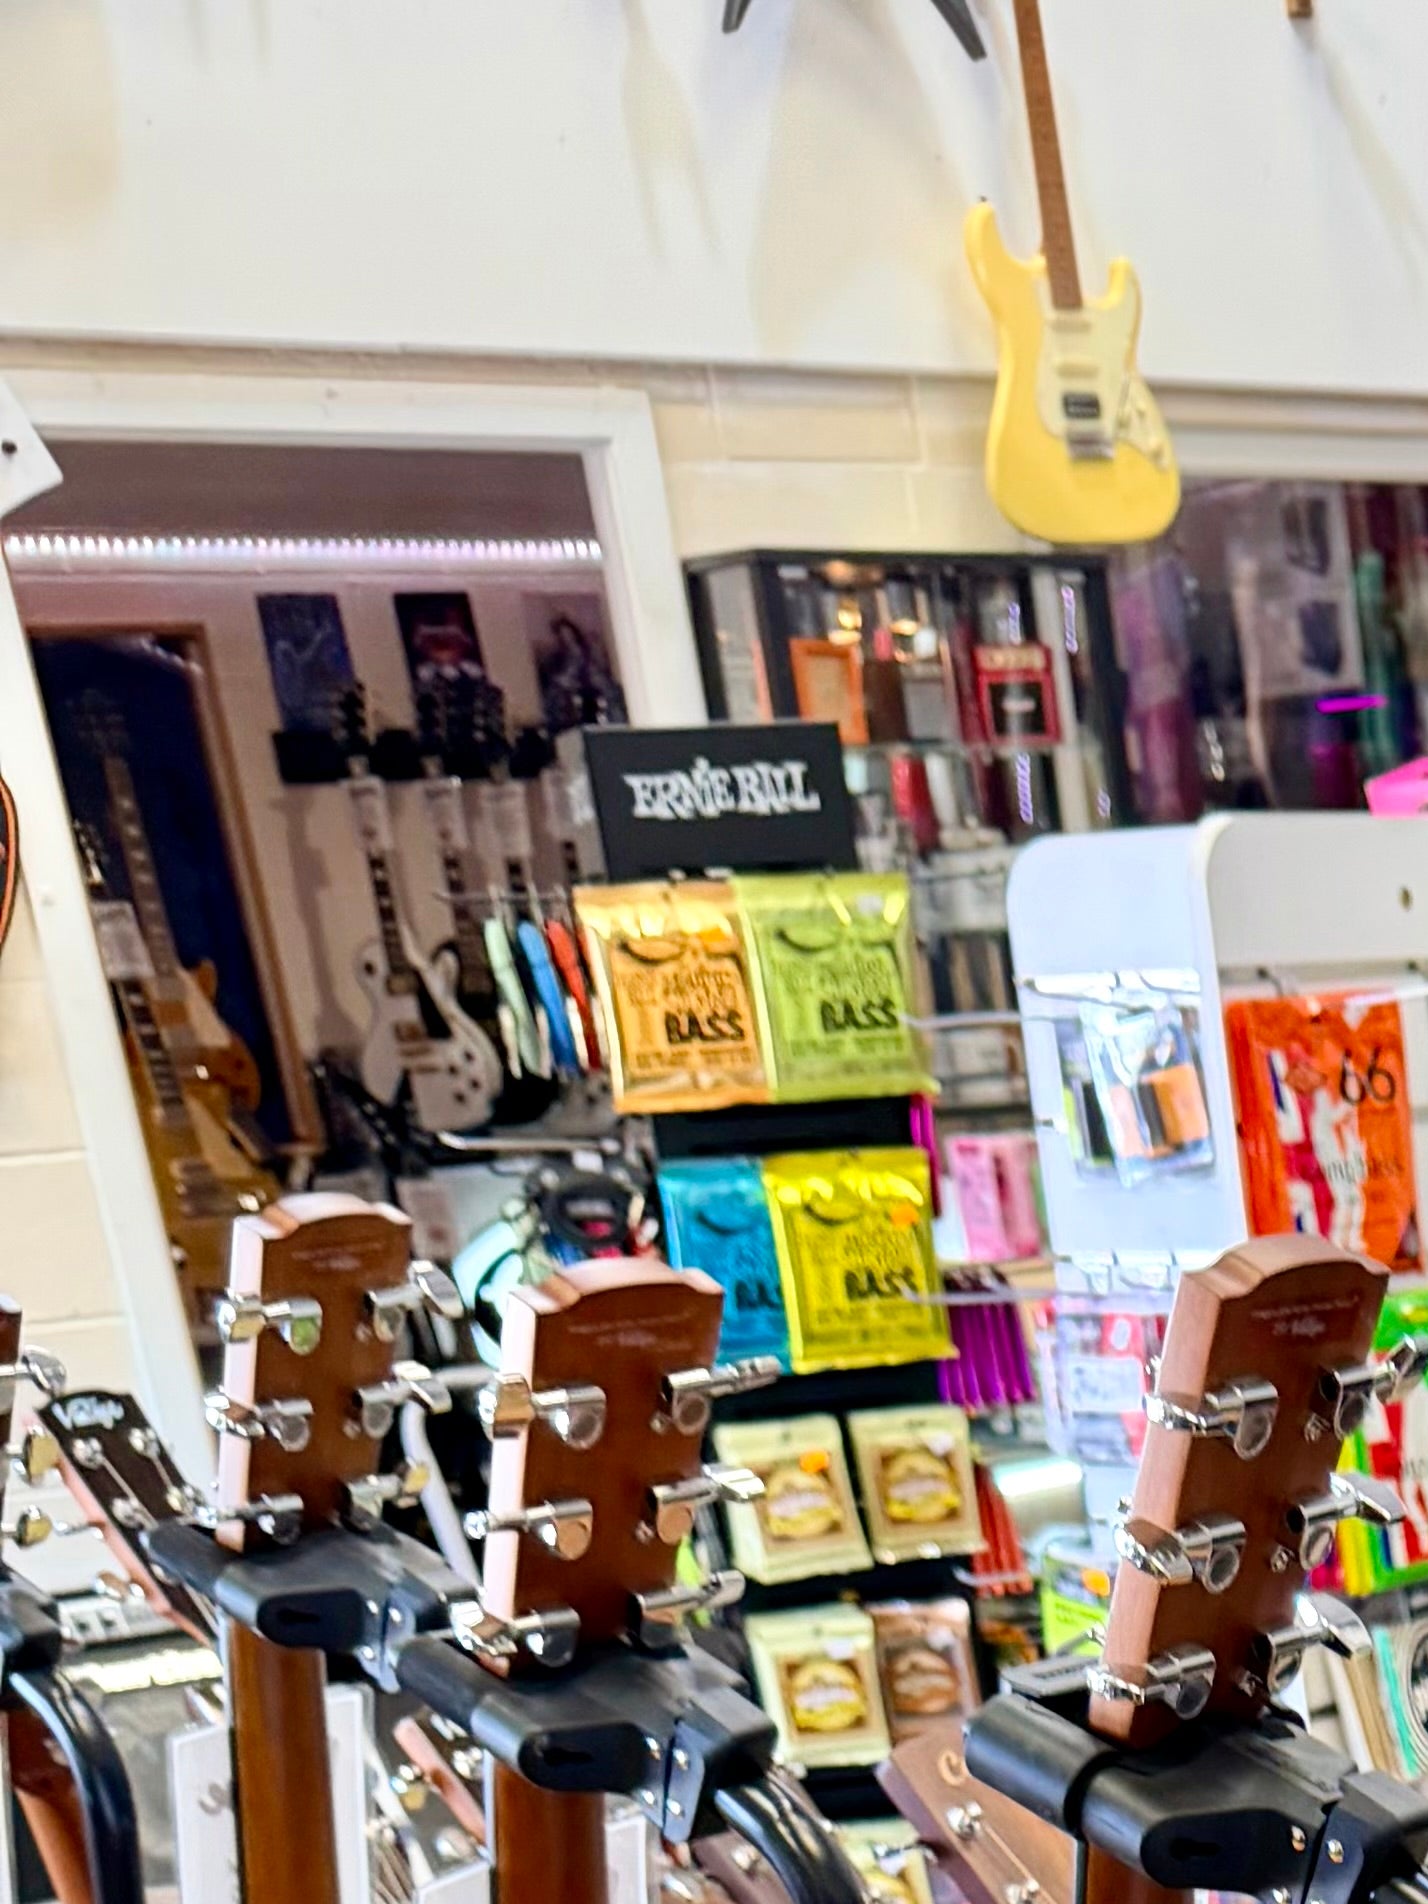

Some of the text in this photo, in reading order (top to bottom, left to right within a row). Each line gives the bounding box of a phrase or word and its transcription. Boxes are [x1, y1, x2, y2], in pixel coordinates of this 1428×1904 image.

[622, 756, 736, 820] ERNIE
[664, 1009, 746, 1045] BASS
[819, 998, 900, 1034] BASS
[1339, 1046, 1397, 1106] 66
